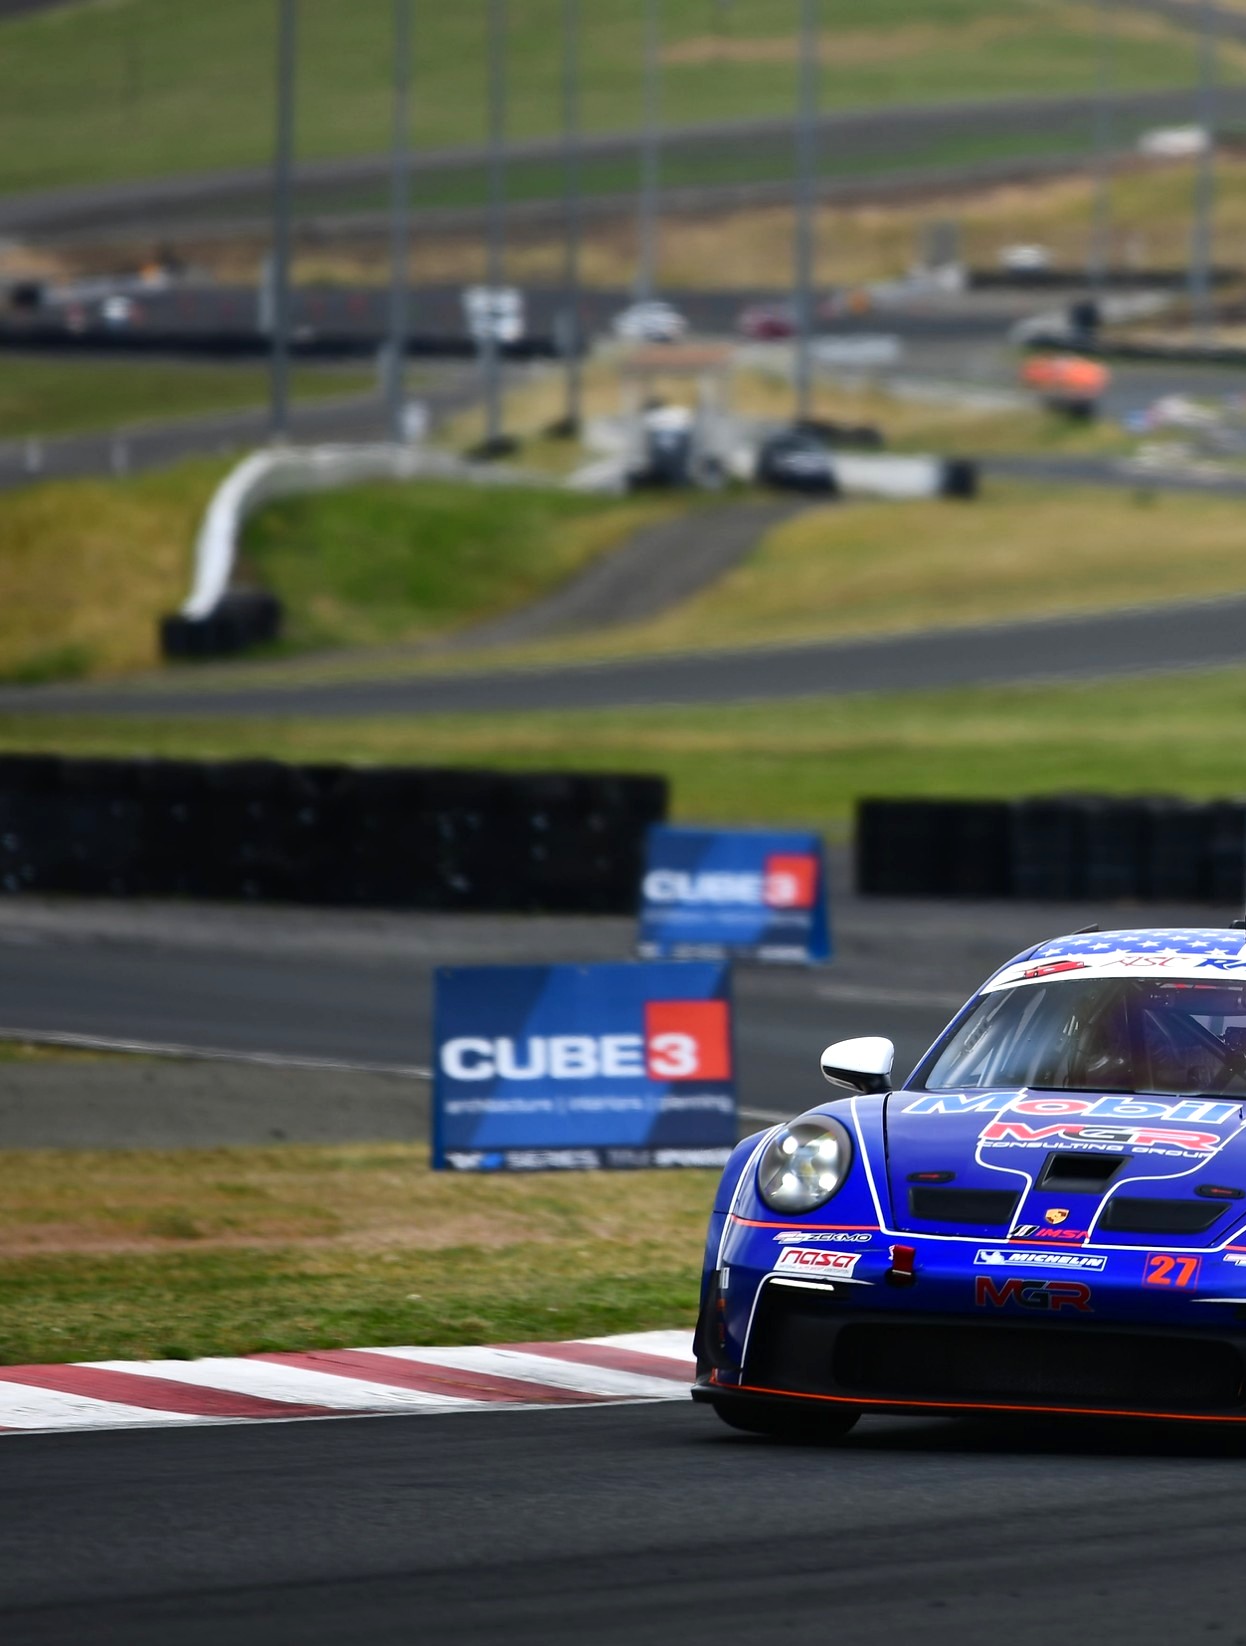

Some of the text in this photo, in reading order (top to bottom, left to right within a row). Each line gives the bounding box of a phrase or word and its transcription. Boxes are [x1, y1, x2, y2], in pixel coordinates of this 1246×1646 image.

[642, 870, 796, 904] CUBE3
[441, 1034, 699, 1081] CUBE3
[901, 1092, 1244, 1125] Mobil
[977, 1140, 1217, 1159] CONSULTING GROUP
[978, 1122, 1222, 1151] MGR
[808, 1233, 872, 1242] ZEKMO
[1034, 1228, 1089, 1239] IMSA
[780, 1249, 856, 1268] nasa
[1008, 1253, 1104, 1267] MICHELIN
[1147, 1256, 1197, 1287] 27
[974, 1276, 1095, 1313] MGR
